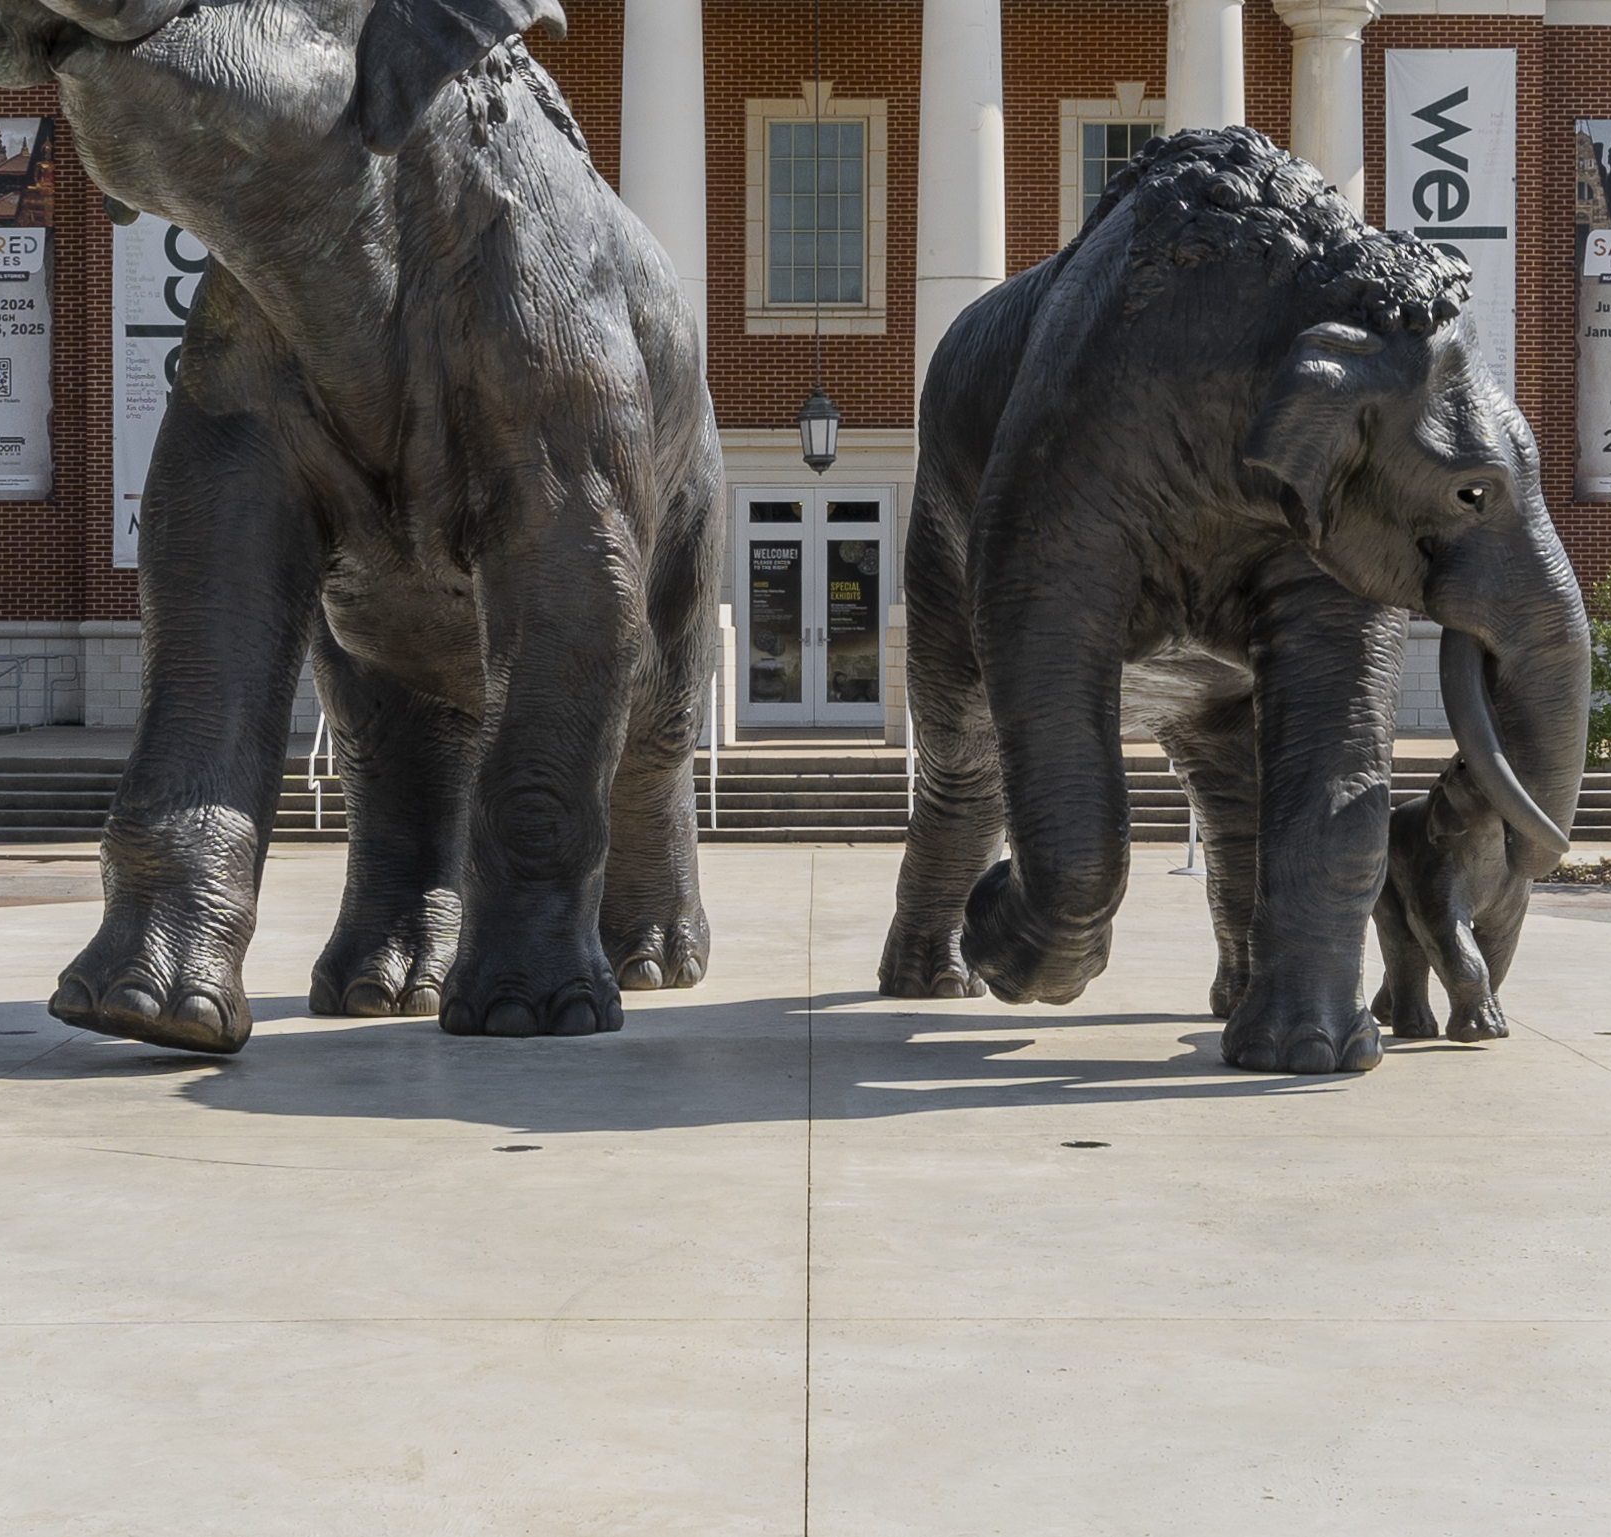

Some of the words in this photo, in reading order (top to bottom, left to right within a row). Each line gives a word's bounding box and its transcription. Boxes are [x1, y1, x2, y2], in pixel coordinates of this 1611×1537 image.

[1410, 86, 1508, 269] wel
[0, 299, 35, 310] 2024
[11, 324, 45, 335] 2025
[753, 548, 798, 559] WELCOME!
[830, 581, 860, 591] SPECIAL
[830, 591, 861, 600] EXHIBITS
